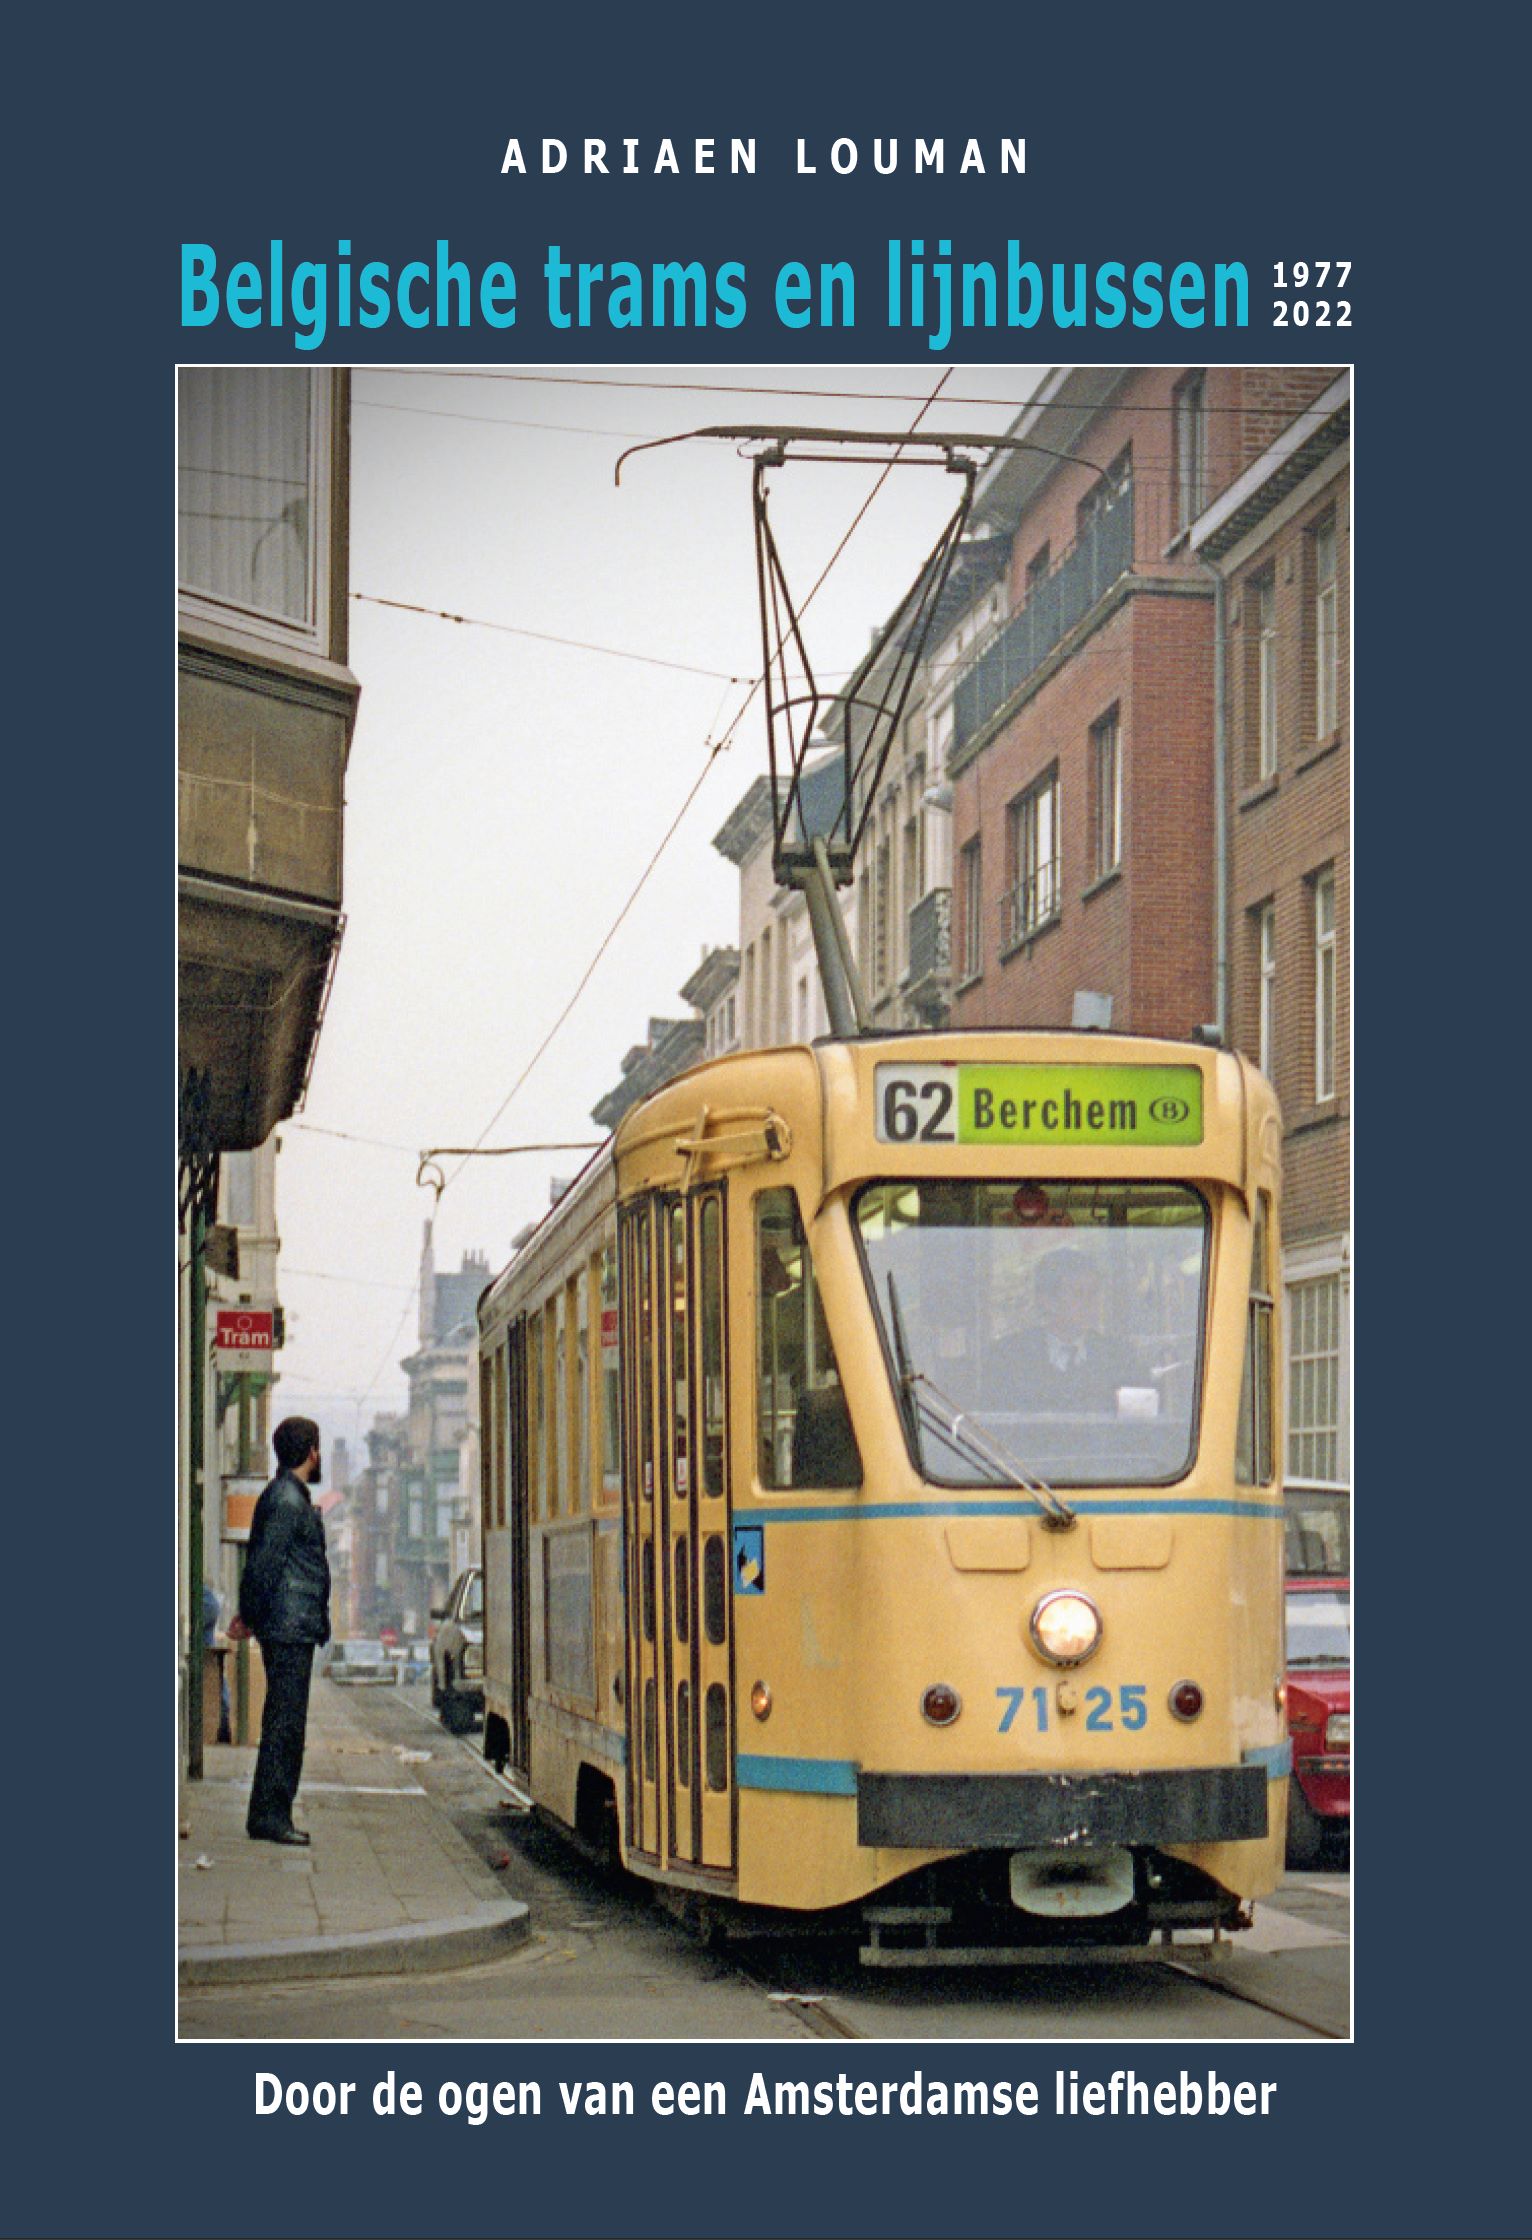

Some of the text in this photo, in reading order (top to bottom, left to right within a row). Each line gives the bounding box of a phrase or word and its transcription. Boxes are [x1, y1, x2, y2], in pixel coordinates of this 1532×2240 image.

[884, 1080, 955, 1142] 62
[974, 1088, 1137, 1130] Berchem
[220, 1327, 269, 1345] Tram
